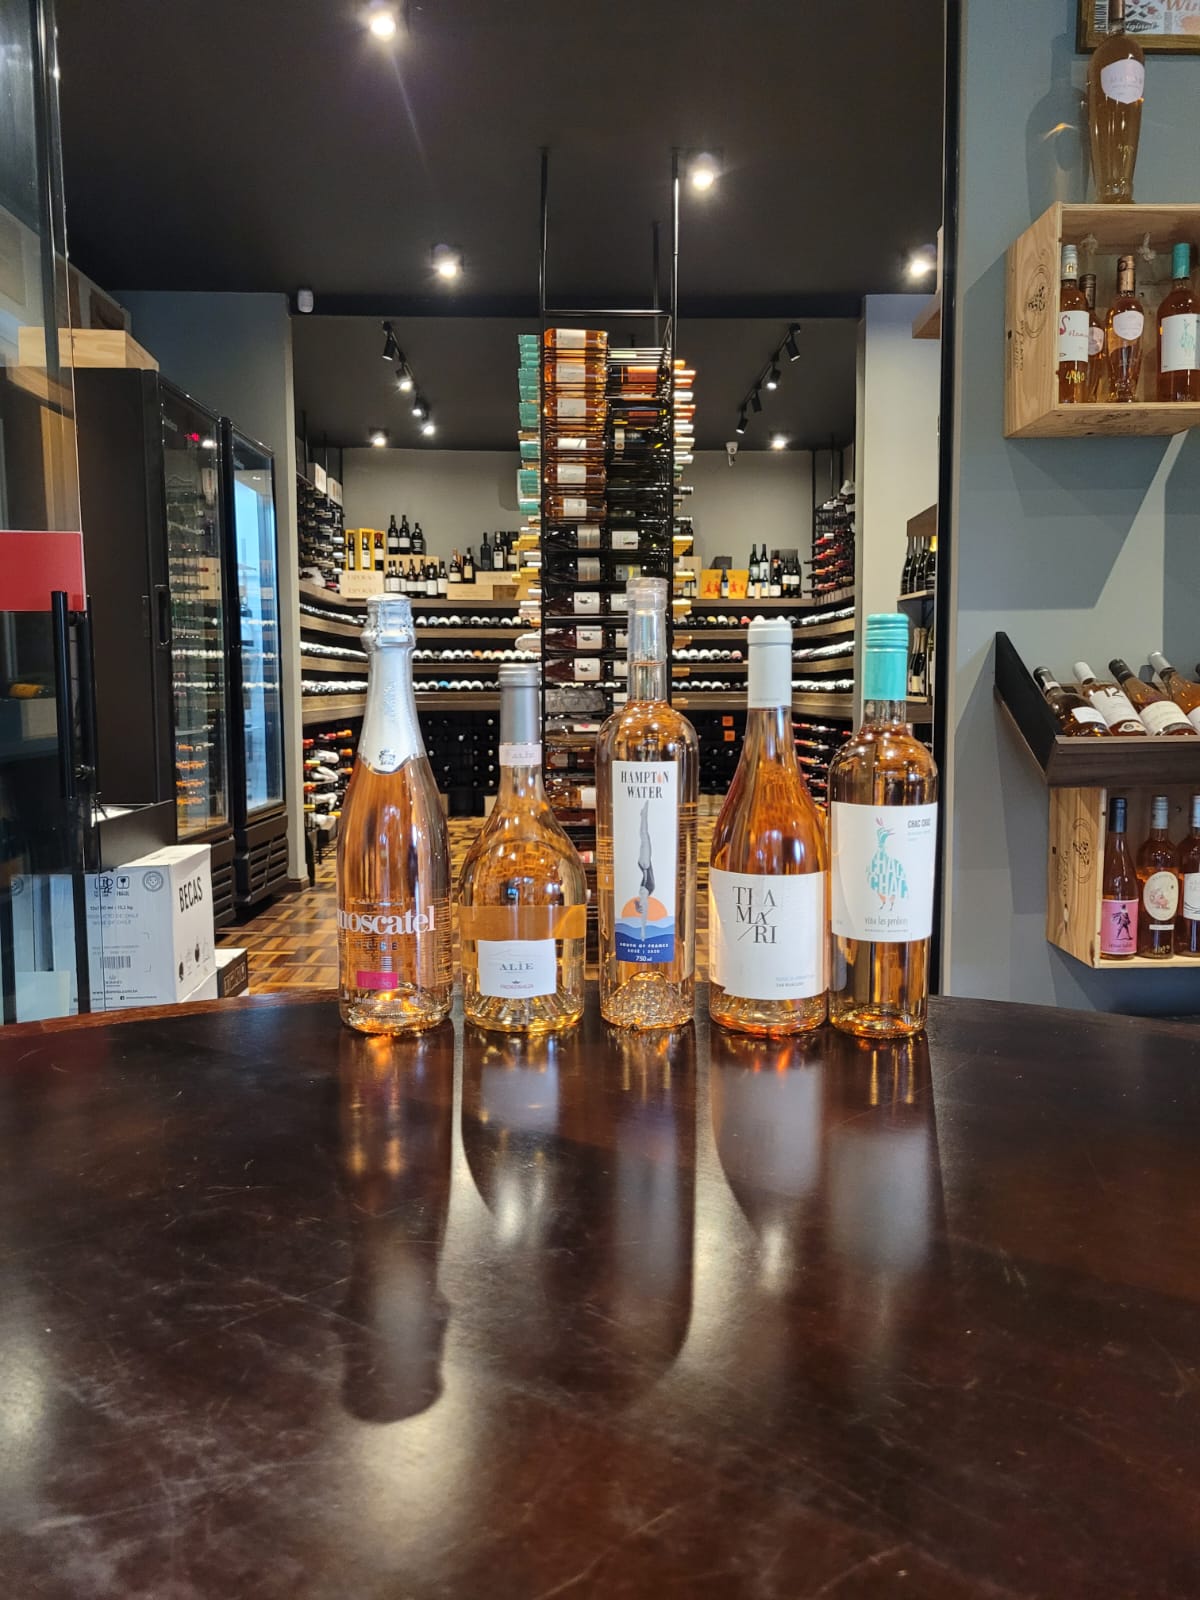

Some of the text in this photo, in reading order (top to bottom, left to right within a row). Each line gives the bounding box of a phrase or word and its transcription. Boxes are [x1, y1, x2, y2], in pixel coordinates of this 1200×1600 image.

[621, 770, 669, 784] HAMPTON
[627, 786, 663, 799] WATER
[179, 876, 203, 913] BECAS
